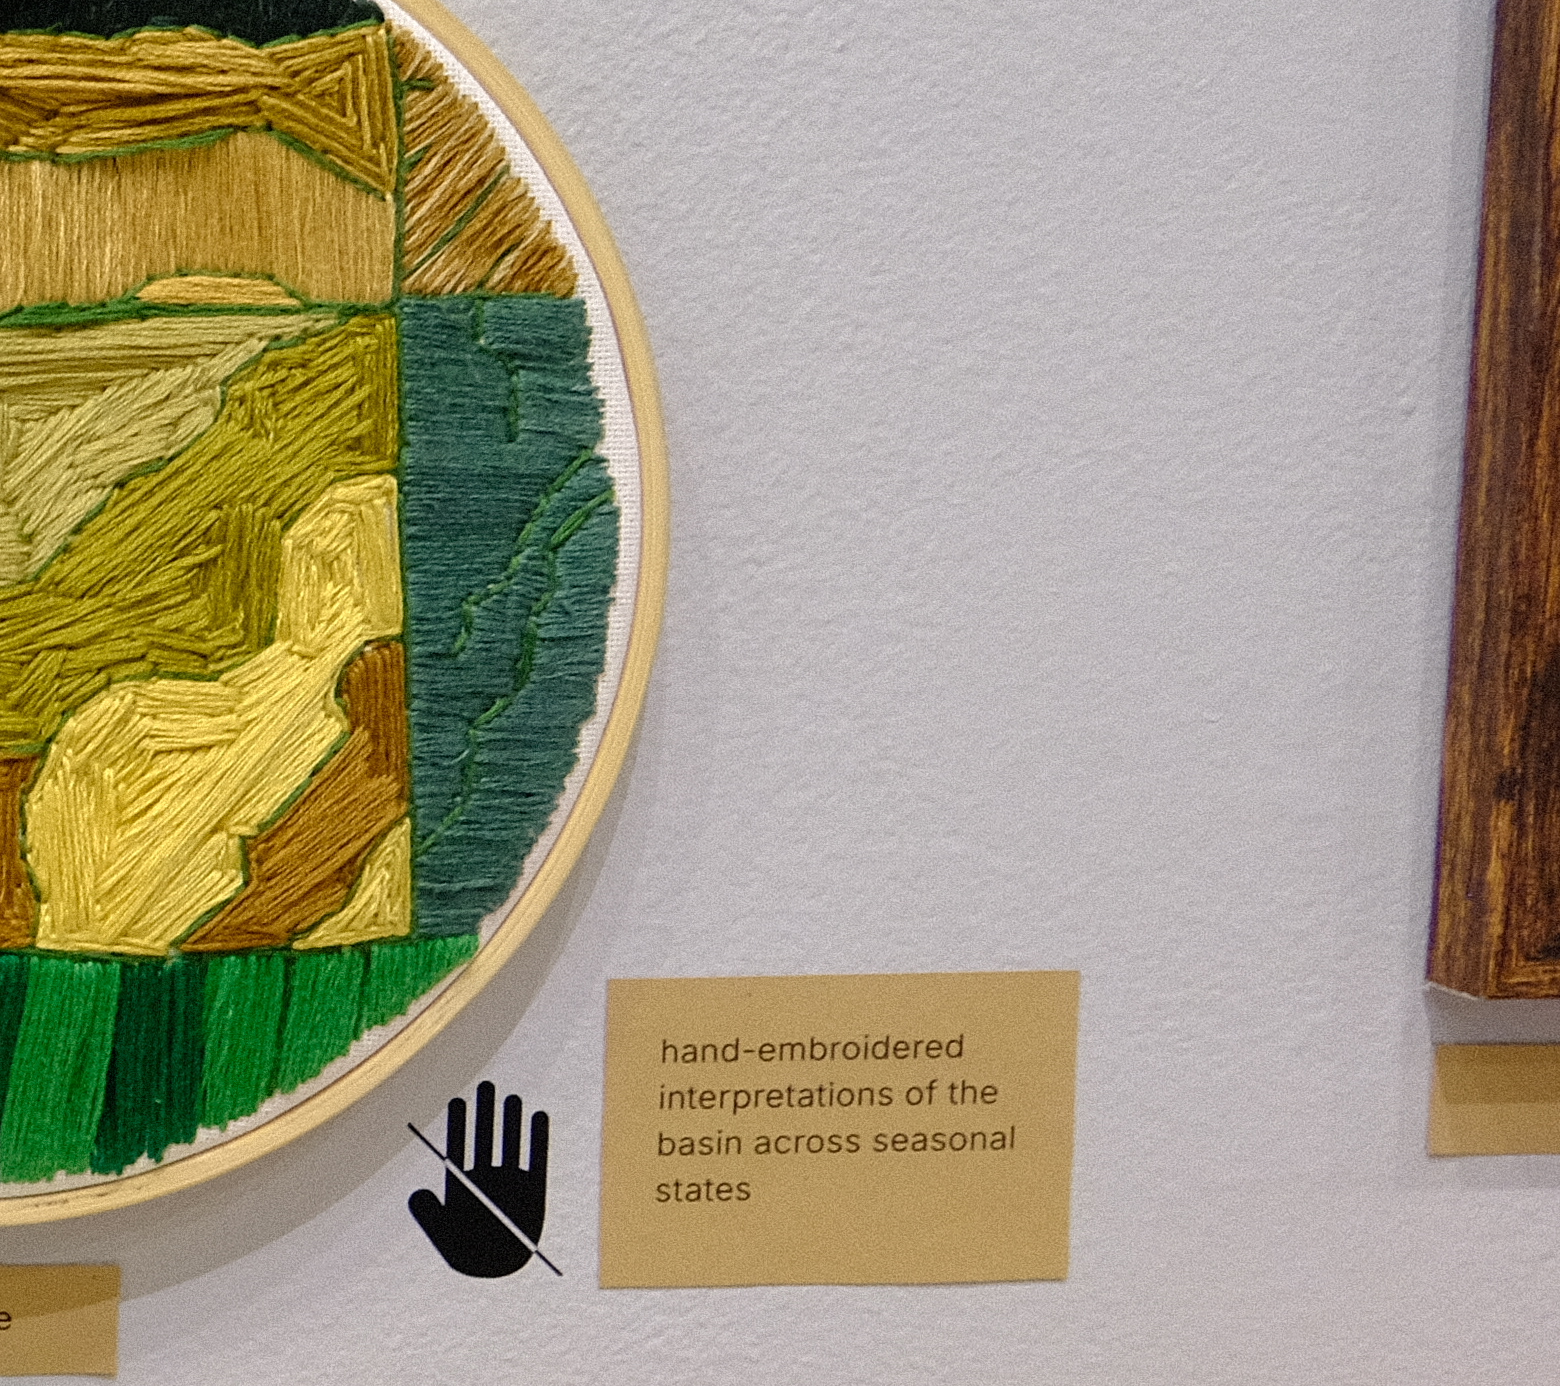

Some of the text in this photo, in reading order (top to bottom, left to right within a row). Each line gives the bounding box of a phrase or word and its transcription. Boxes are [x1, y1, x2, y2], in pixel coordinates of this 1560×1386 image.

[662, 1034, 964, 1063] hand-embroidered
[659, 1080, 998, 1115] interpretations of the
[657, 1126, 1016, 1157] basin across seasonal
[656, 1178, 751, 1202] states
